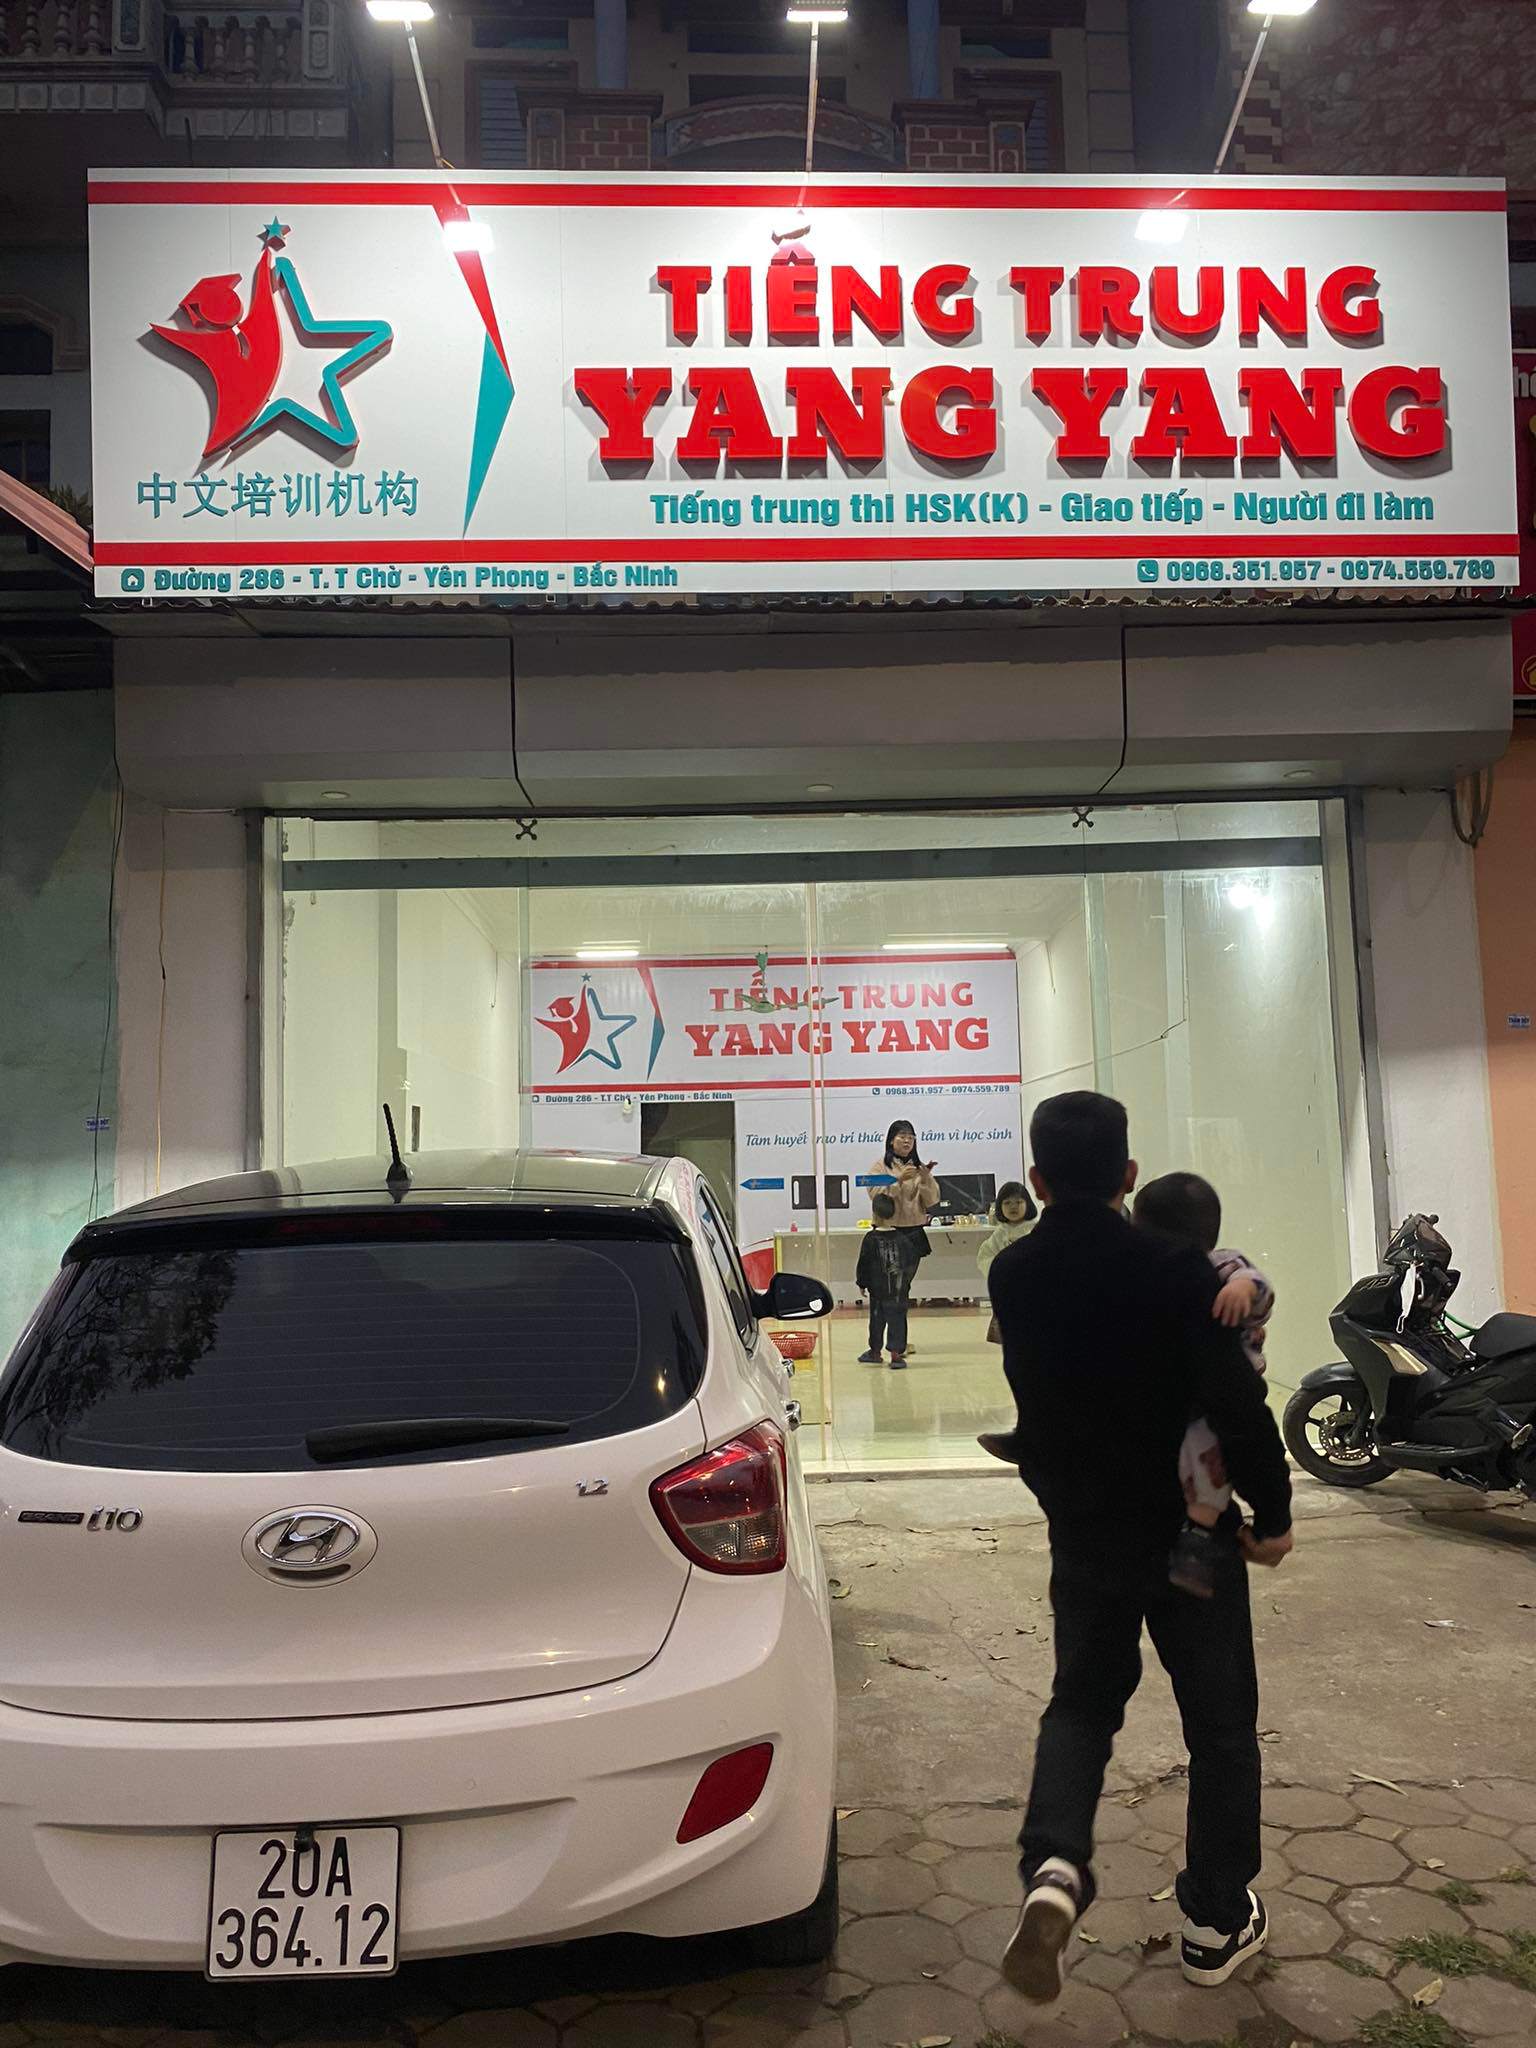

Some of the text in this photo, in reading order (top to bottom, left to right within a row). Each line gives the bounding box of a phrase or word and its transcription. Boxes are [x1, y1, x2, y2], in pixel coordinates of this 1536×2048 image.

[657, 224, 1382, 342] TIẾNG TRUNG
[574, 366, 1448, 466] YANG YANG
[137, 470, 419, 519] 中文培训机构
[650, 490, 741, 526] Tiếng
[751, 494, 840, 526] trung
[850, 493, 894, 523] thi
[906, 492, 1028, 524] HSK(K)
[1061, 492, 1133, 522] Giao
[1141, 488, 1203, 524] tiếp
[1234, 490, 1327, 524] Người
[1336, 491, 1365, 521] đi
[1374, 491, 1434, 521] làm
[154, 567, 231, 592] Đường
[239, 568, 285, 589] 286
[356, 565, 400, 589] Chờ
[424, 565, 467, 588] Yên
[475, 565, 549, 590] Phong
[573, 561, 618, 587] Bắc
[624, 565, 678, 587] Ninh
[1166, 560, 1321, 581] 0968.351.957
[1341, 559, 1495, 580] 0974.559.789
[838, 982, 973, 1009] TRUNG
[685, 1017, 990, 1057] YANG YANG
[745, 1133, 771, 1146] Tâm
[921, 1129, 945, 1141] tâm
[962, 1128, 984, 1142] học
[986, 1127, 1012, 1140] sinh
[86, 1504, 144, 1533] i10
[257, 1836, 353, 1899] 20A
[215, 1902, 391, 1970] 364.12
